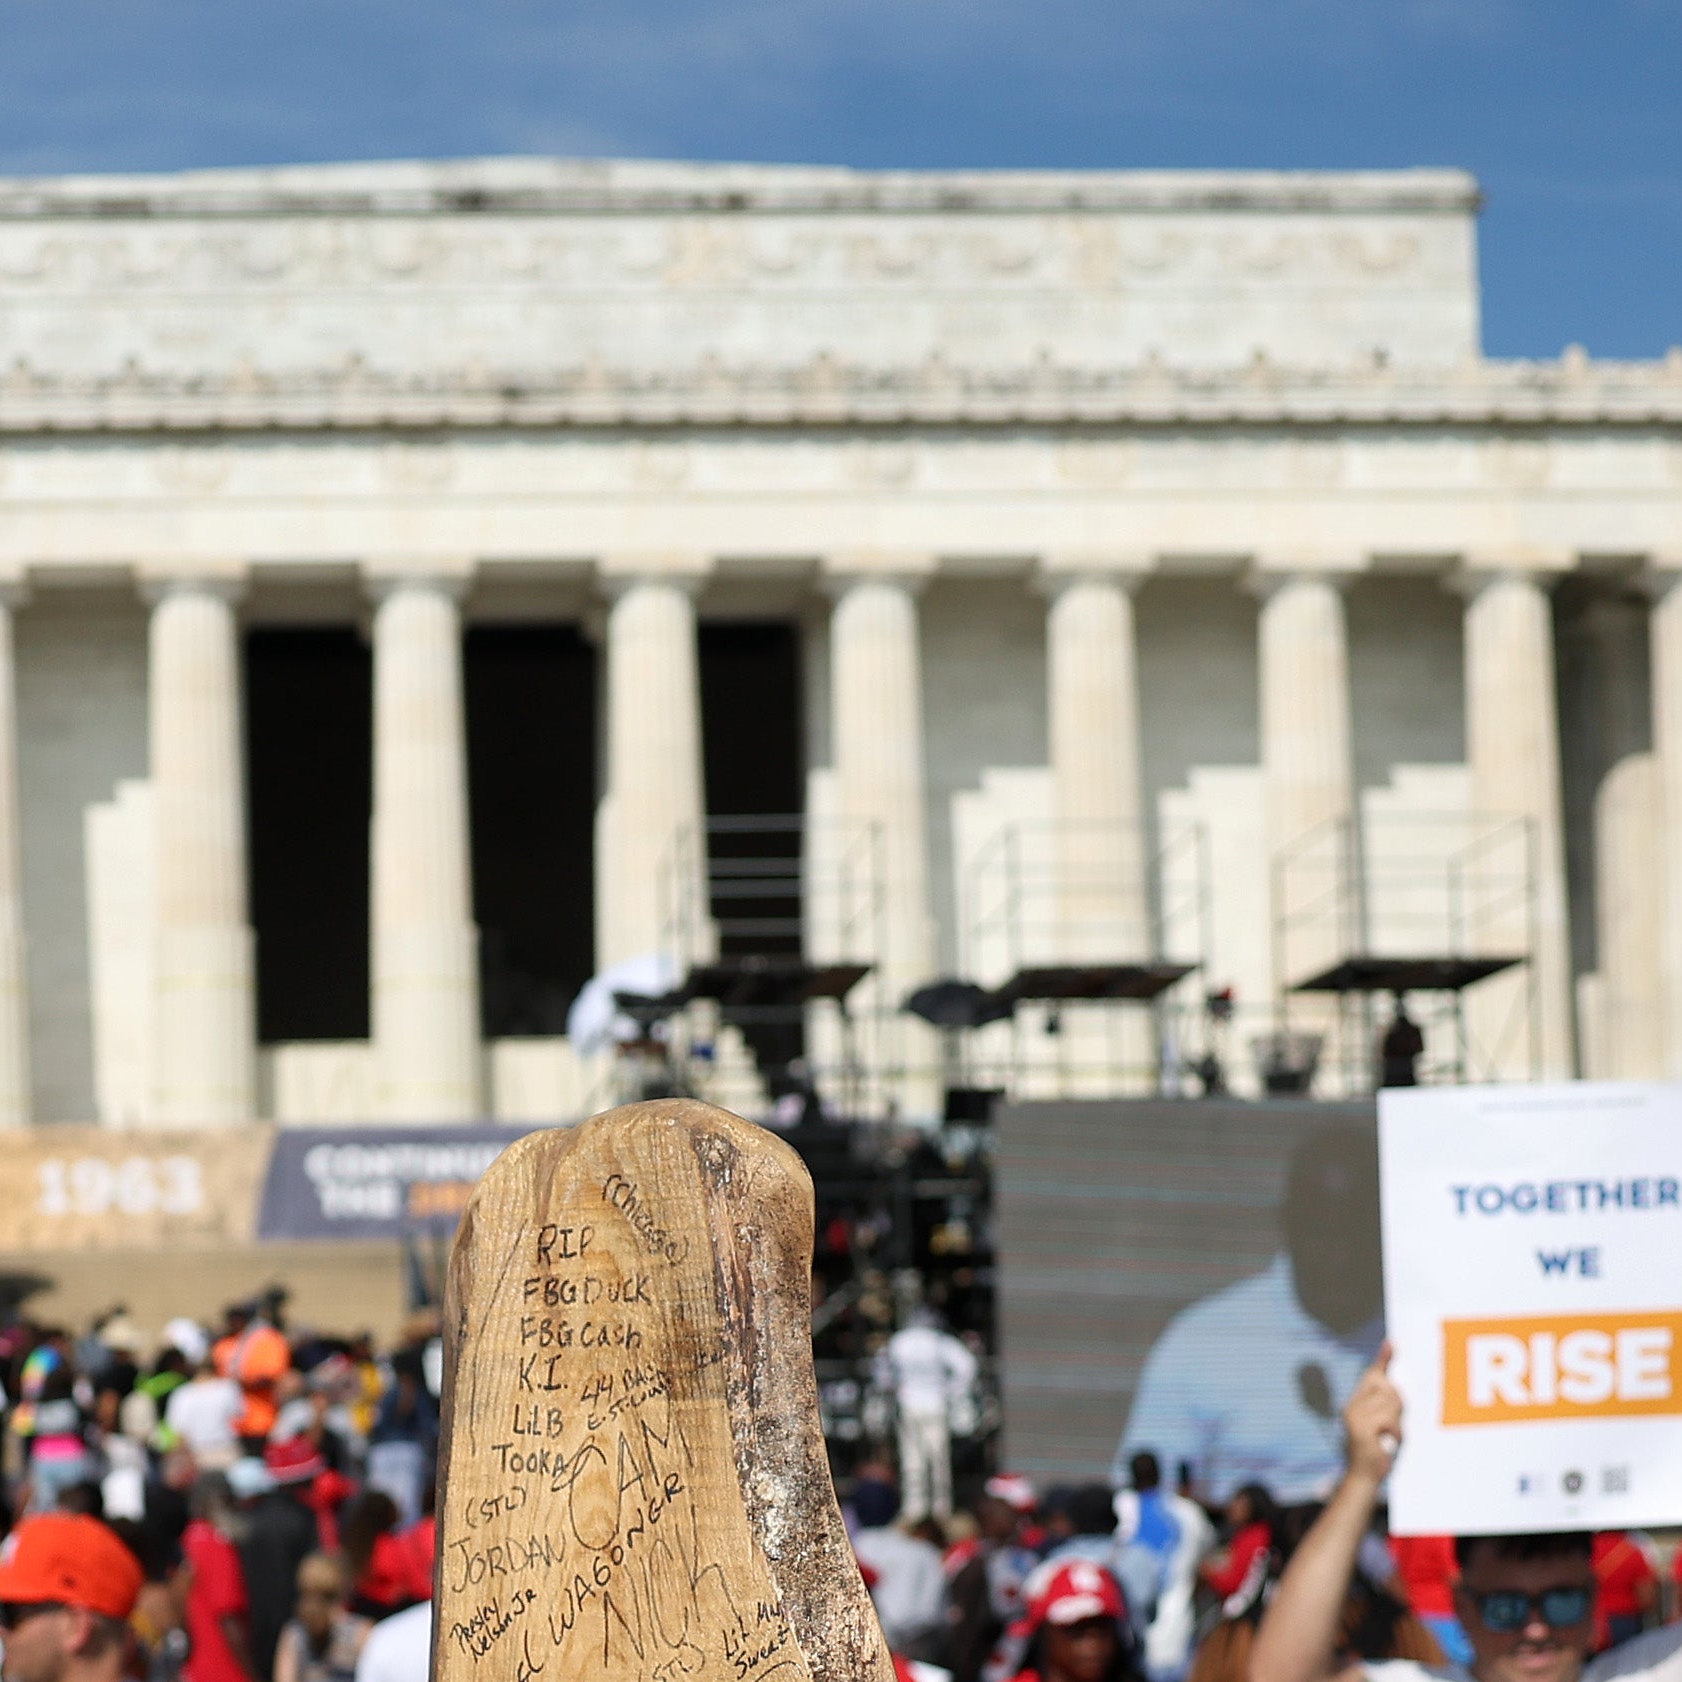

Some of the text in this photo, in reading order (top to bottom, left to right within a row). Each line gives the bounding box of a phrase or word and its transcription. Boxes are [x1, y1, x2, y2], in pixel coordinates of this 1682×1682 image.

[38, 1157, 203, 1216] 1963
[1450, 1177, 1681, 1216] TOGETHER
[537, 1224, 595, 1265] RIP
[1536, 1247, 1602, 1277] WE
[521, 1317, 573, 1347] FBG
[1466, 1328, 1673, 1407] RISE
